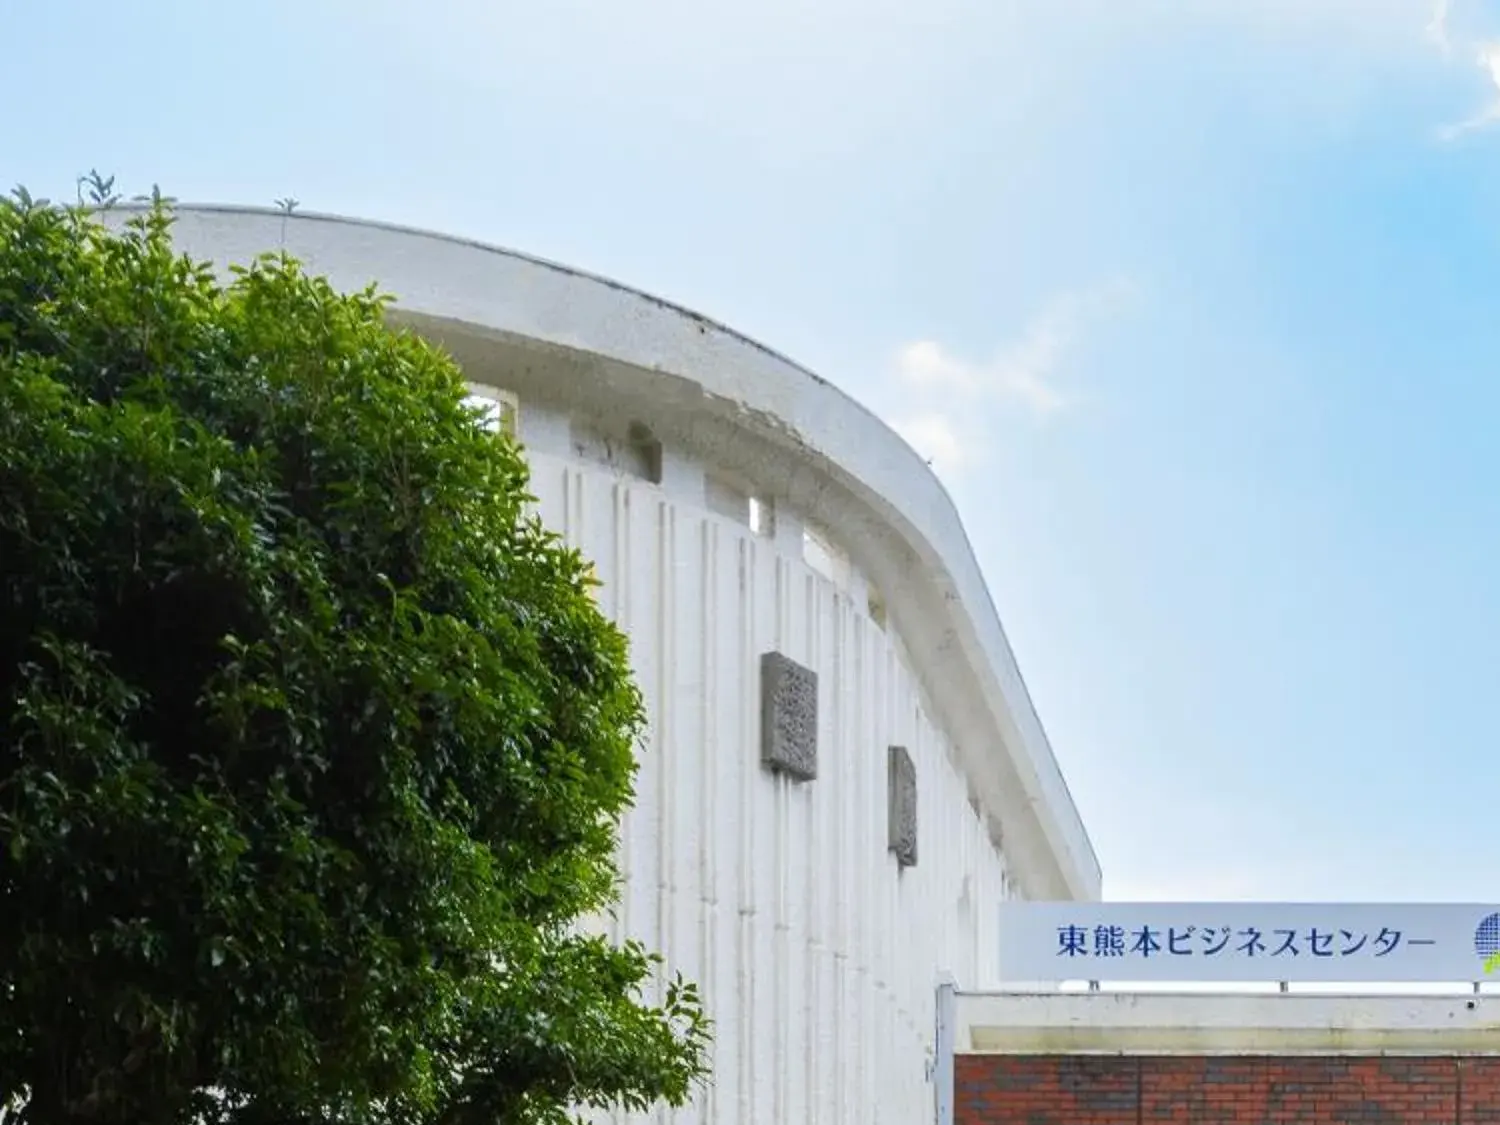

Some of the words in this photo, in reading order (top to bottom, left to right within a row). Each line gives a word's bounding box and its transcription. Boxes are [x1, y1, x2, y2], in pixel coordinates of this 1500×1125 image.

[1056, 924, 1437, 958] 東熊本ビジネスセンター
